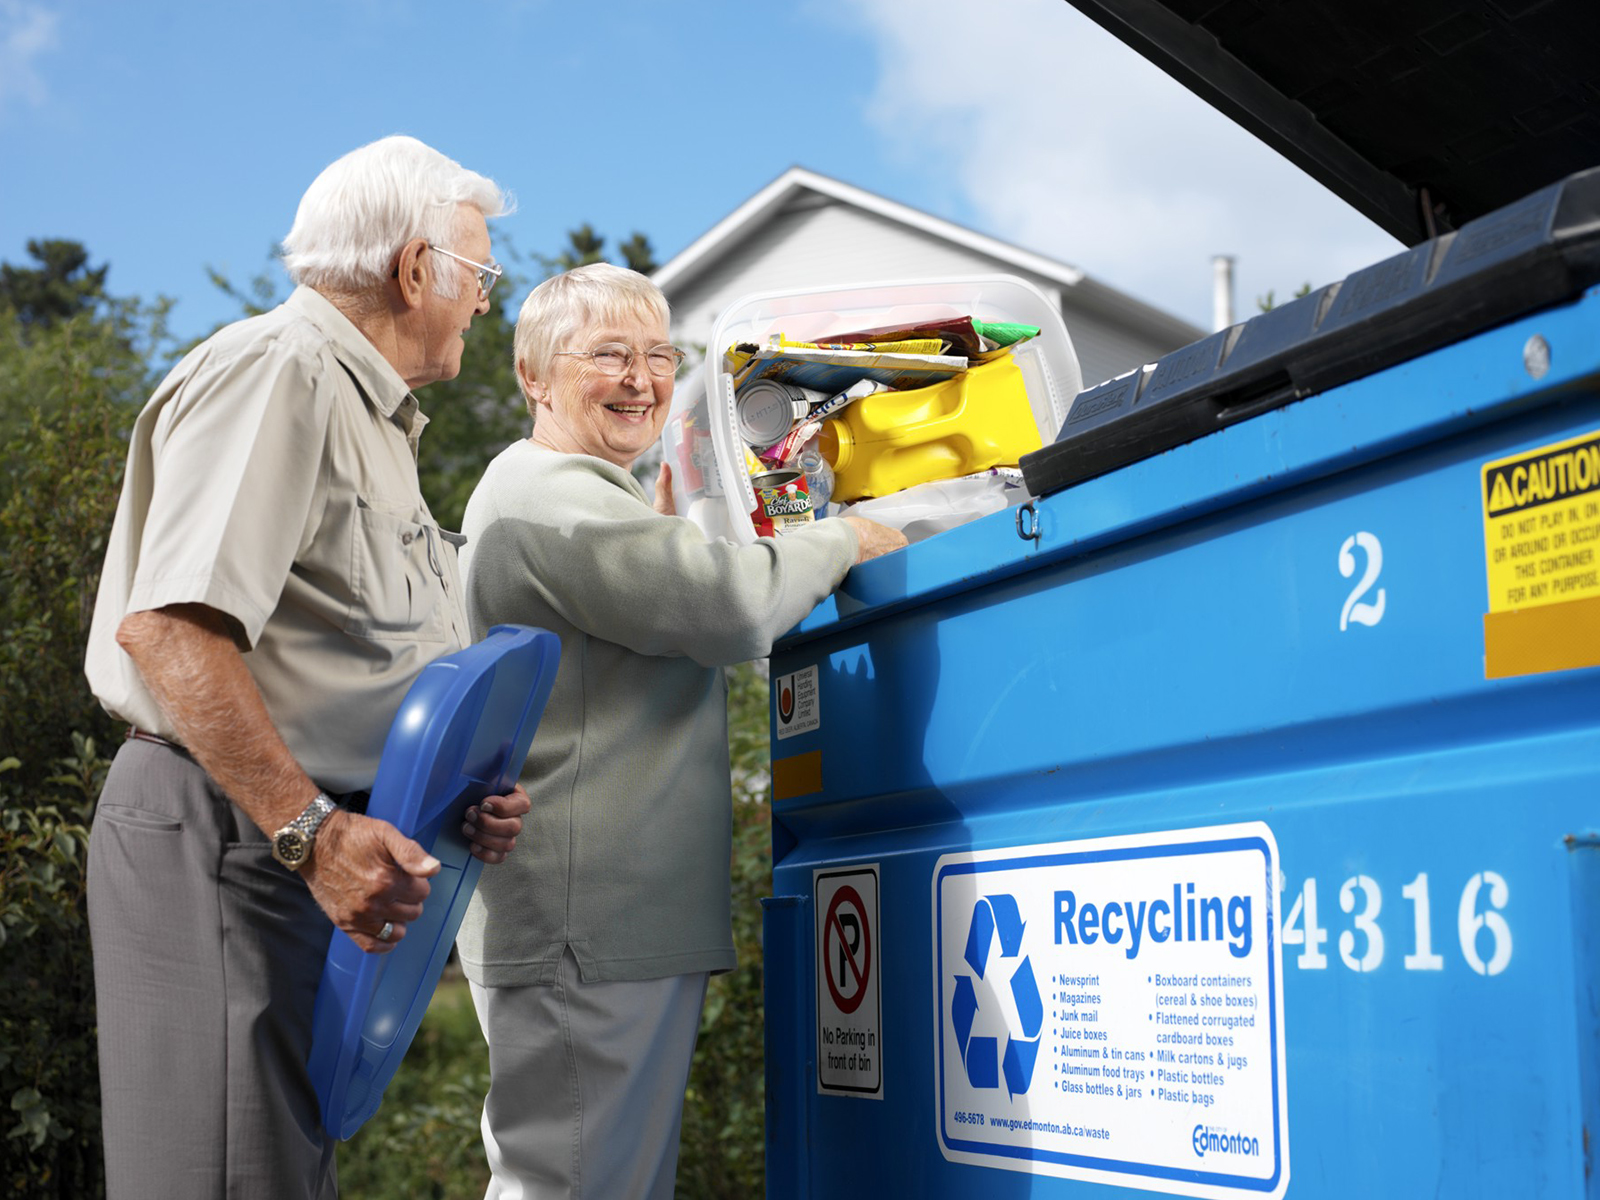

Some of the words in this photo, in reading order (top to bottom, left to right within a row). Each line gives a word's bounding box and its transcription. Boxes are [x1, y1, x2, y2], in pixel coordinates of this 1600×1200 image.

[1511, 446, 1600, 506] CAUTION
[1502, 523, 1514, 539] DO
[1518, 517, 1536, 534] NOT
[1541, 511, 1563, 529] PLAY
[1494, 546, 1506, 563] OR
[1511, 536, 1549, 558] AROUND
[1554, 531, 1567, 549] OR
[1515, 561, 1536, 578] THIS
[1541, 548, 1594, 575] CONTAINER
[1338, 531, 1386, 631] 2
[1508, 586, 1526, 603] FOR
[1531, 582, 1548, 599] ANY
[1054, 882, 1253, 960] Recycling
[1282, 870, 1513, 976] 4316
[1059, 973, 1100, 989] Newsprint
[1155, 974, 1198, 987] Boxboard
[1200, 973, 1253, 987] containers
[1060, 991, 1102, 1007] Magazines
[1155, 992, 1187, 1009] (cereal
[1190, 992, 1197, 1006] &
[1200, 993, 1223, 1007] shoe
[1225, 993, 1258, 1011] boxes)
[1060, 1009, 1079, 1022] Junk
[1081, 1009, 1098, 1022] mail
[1156, 1011, 1199, 1026] Flattened
[1201, 1014, 1255, 1030] corrugated
[822, 1026, 834, 1045] No
[836, 1027, 866, 1051] Parking
[867, 1028, 876, 1047] in
[1060, 1026, 1082, 1040] Juice
[1083, 1028, 1108, 1041] boxes
[1156, 1031, 1203, 1045] cardboard
[1205, 1032, 1234, 1047] boxes
[828, 1051, 847, 1070] front
[848, 1053, 857, 1071] of
[858, 1053, 872, 1072] bin
[1061, 1045, 1100, 1059] Aluminum
[1102, 1046, 1109, 1059] &
[1111, 1047, 1122, 1060] tin
[1124, 1050, 1146, 1061] cans
[1157, 1049, 1176, 1063] Milk
[1178, 1052, 1214, 1065] cartons
[1217, 1052, 1225, 1066] &
[1227, 1053, 1248, 1071] jugs
[1061, 1062, 1101, 1077] Aluminum
[1102, 1064, 1121, 1078] food
[1123, 1067, 1145, 1083] trays
[1157, 1068, 1189, 1083] Plastic
[1191, 1070, 1224, 1086] bottles
[1061, 1080, 1084, 1094] Glass
[1085, 1082, 1115, 1096] bottles
[1116, 1083, 1123, 1097] &
[1125, 1085, 1143, 1100] jars
[1158, 1087, 1190, 1103] Plastic
[1192, 1090, 1215, 1108] bags
[954, 1111, 985, 1126] 496-5678
[990, 1116, 1110, 1140] www.gov.edmonton.ab.ca/waste
[1192, 1124, 1259, 1158] Edmonton
